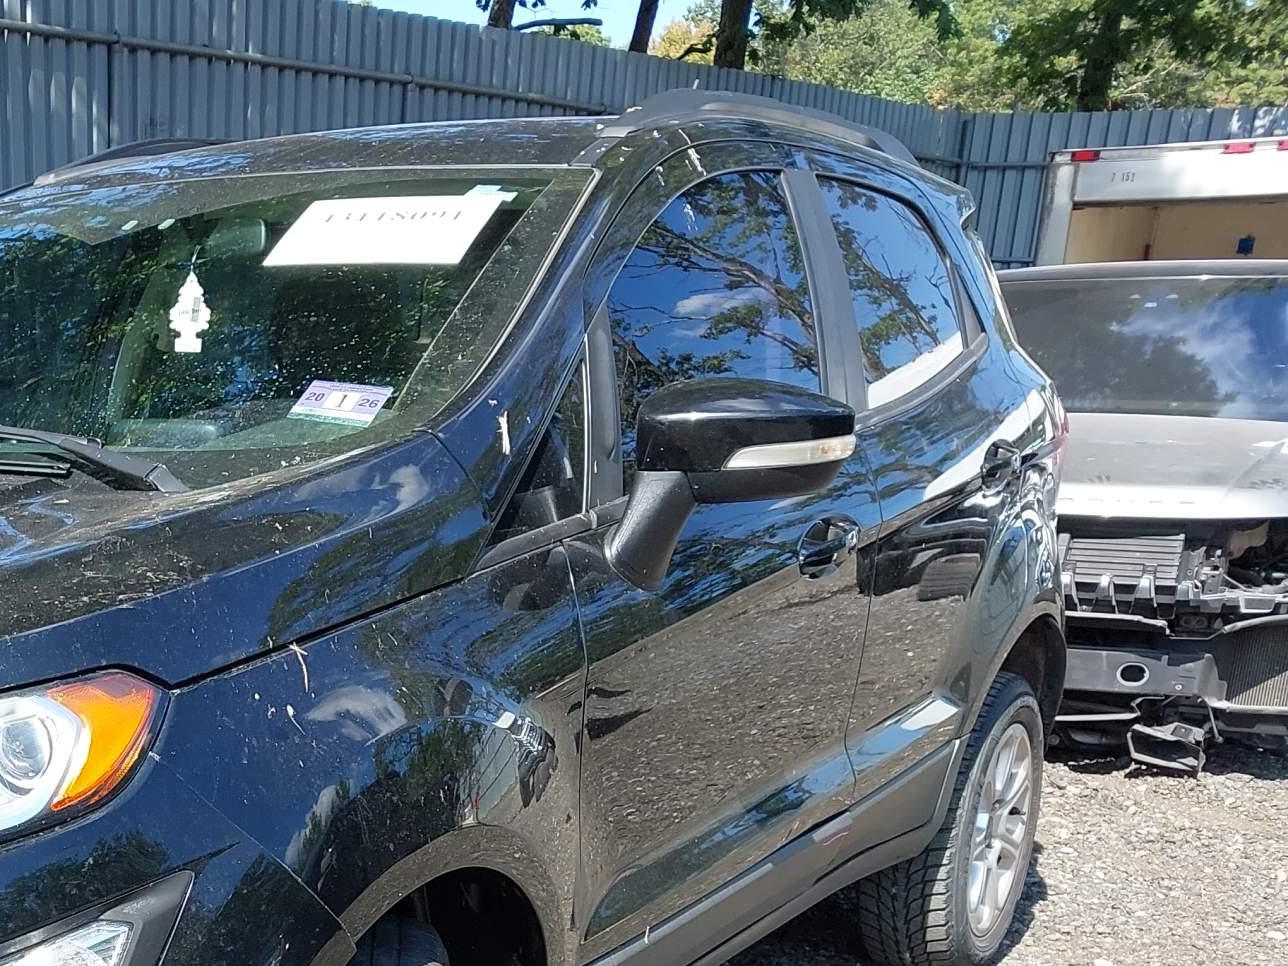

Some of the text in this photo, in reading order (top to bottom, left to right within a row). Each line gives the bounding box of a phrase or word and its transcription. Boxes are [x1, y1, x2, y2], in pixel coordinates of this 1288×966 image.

[305, 391, 380, 409] 20 1 26
